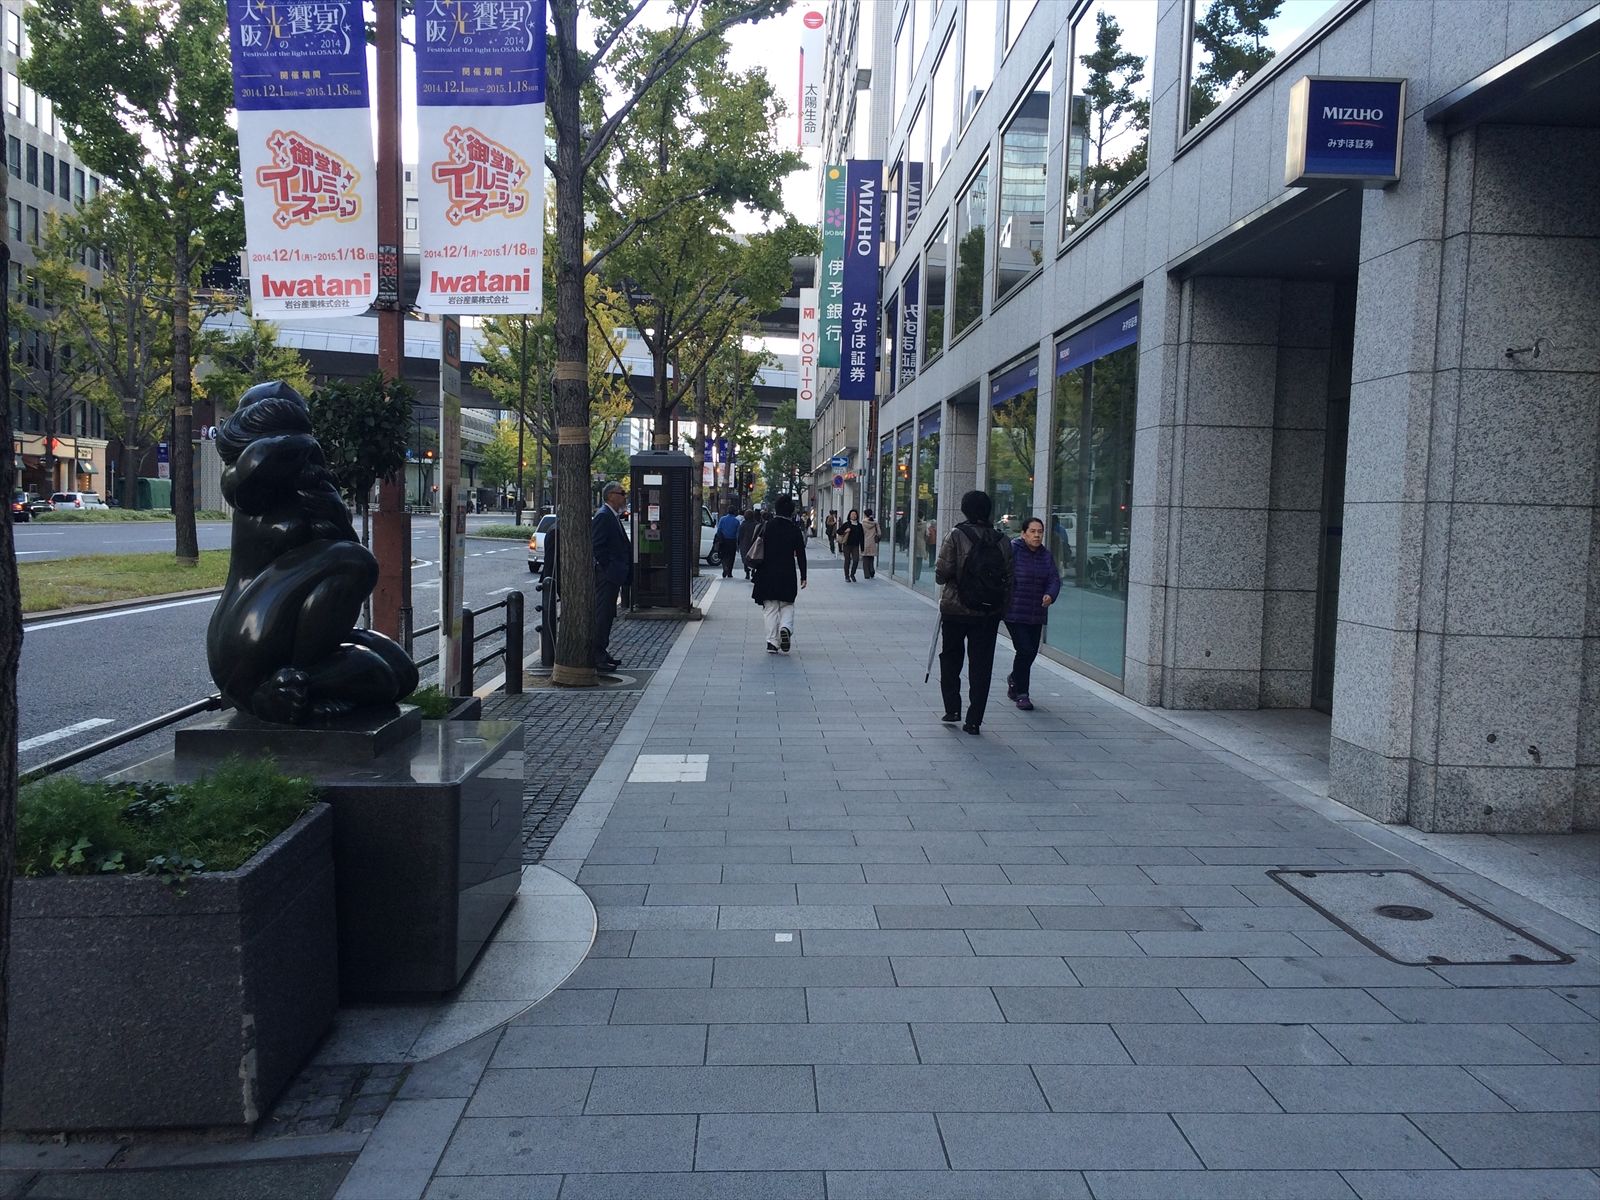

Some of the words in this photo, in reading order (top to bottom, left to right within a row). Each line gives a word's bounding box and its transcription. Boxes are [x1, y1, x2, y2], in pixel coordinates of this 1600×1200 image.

[320, 40, 341, 49] 2014
[504, 37, 524, 46] 2014
[804, 83, 818, 133] 太陽生命
[1322, 106, 1384, 121] MIZUHO
[1327, 138, 1374, 149] みずほ証券
[857, 179, 875, 256] MIZUHO
[262, 273, 371, 297] Iwatani
[430, 268, 530, 293] Iwatani
[284, 299, 350, 309] 岩谷産業株式会社
[448, 295, 509, 304] 岩谷産業株式会社
[825, 260, 844, 341] 伊予銀行
[850, 302, 868, 383] みずほ証券
[800, 332, 815, 400] MORITO
